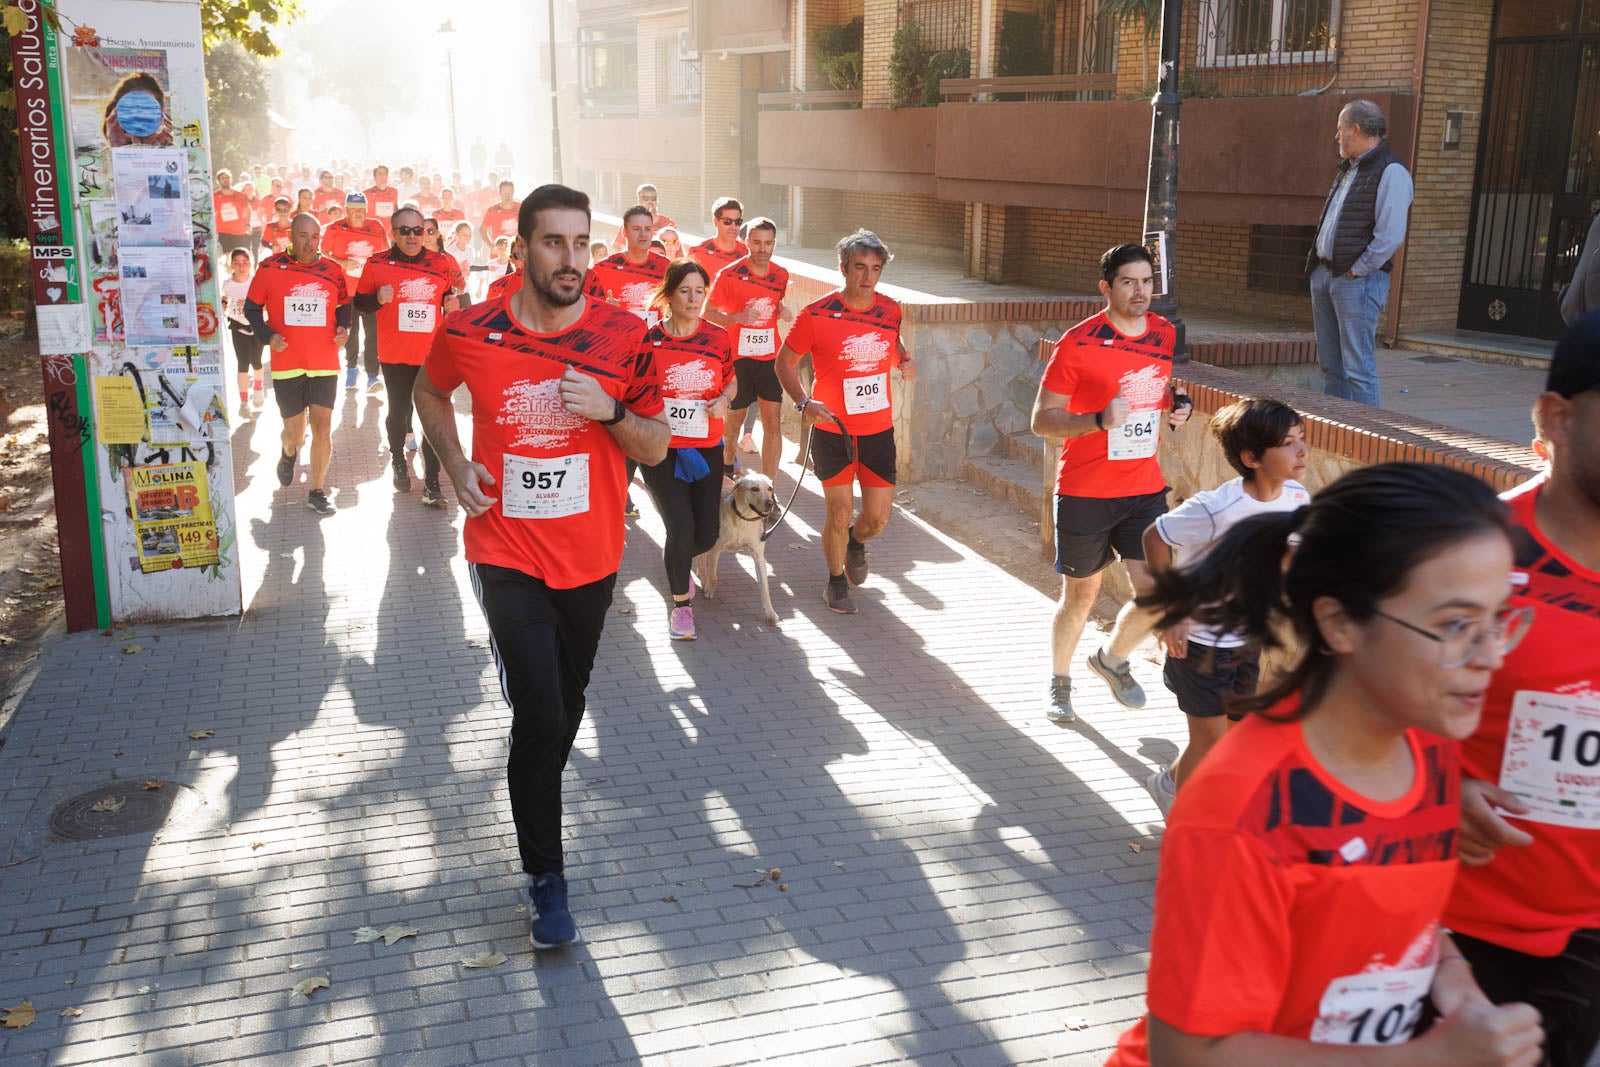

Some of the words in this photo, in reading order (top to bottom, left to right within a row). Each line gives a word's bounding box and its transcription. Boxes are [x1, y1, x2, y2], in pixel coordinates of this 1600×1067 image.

[139, 38, 195, 49] Ayuntamiento
[49, 46, 57, 68] Ruta
[35, 248, 73, 257] MPS
[291, 303, 318, 312] 1437
[407, 310, 427, 319] 855
[746, 335, 769, 344] 1553
[668, 371, 713, 382] carrera
[855, 383, 879, 397] 206
[506, 398, 566, 412] carre
[506, 413, 583, 427] cruzroja.es
[670, 407, 696, 420] 207
[1124, 421, 1152, 437] 564
[137, 470, 194, 485] MOLINA
[521, 470, 567, 490] 957
[176, 485, 200, 510] B
[180, 531, 201, 544] 149
[206, 530, 215, 541] €
